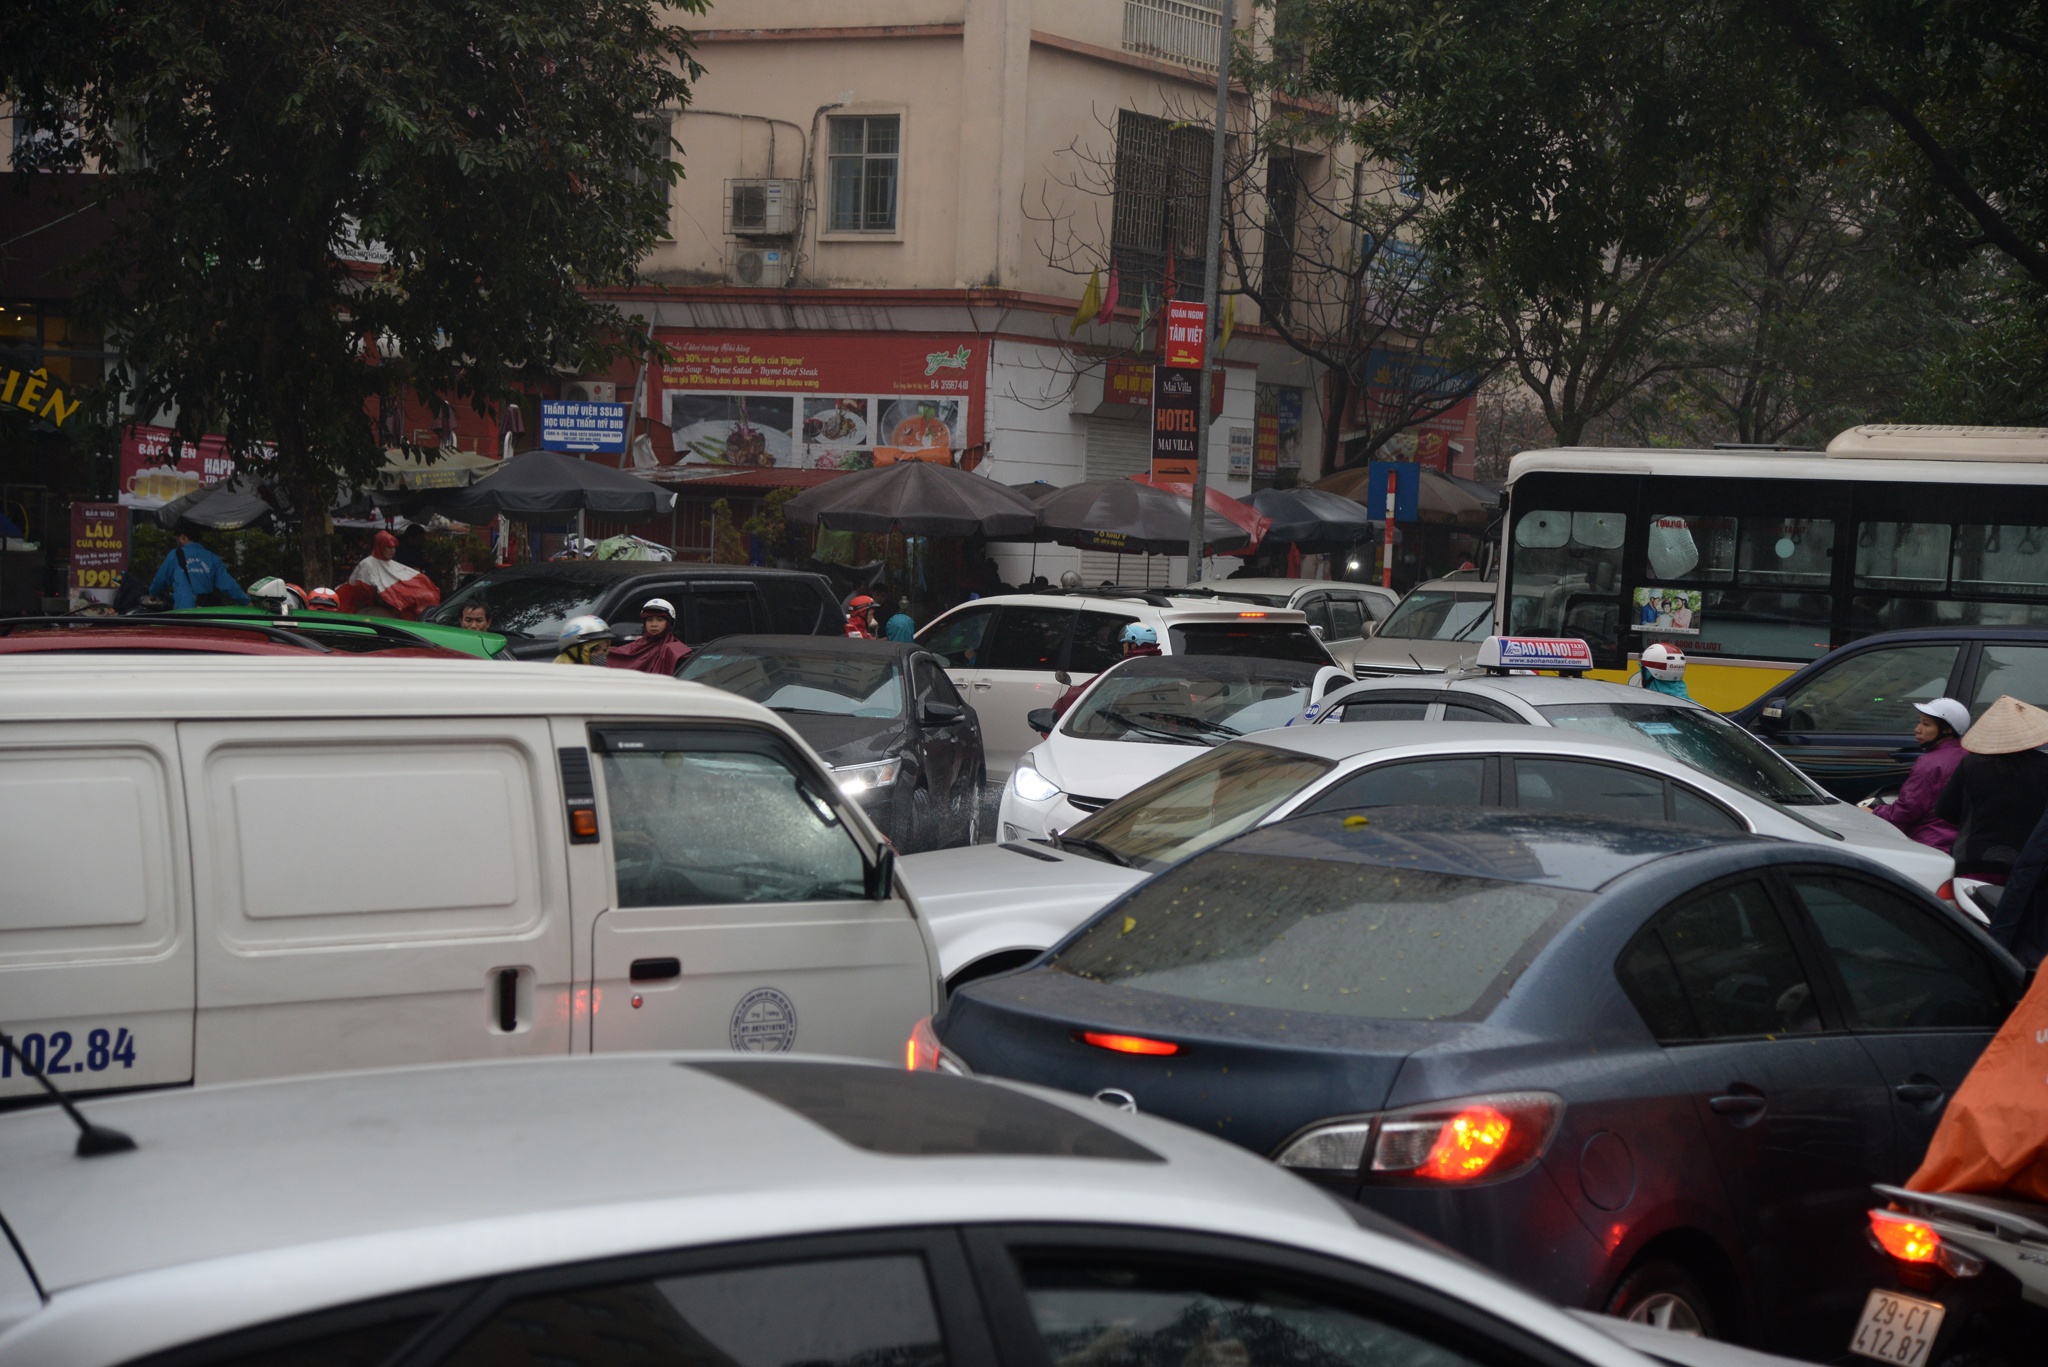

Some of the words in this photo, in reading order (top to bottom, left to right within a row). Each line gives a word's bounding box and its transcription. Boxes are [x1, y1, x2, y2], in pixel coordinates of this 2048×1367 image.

[1171, 308, 1187, 319] QUÁN
[1187, 310, 1204, 320] NGON
[1169, 323, 1186, 342] TÂM
[1187, 325, 1203, 346] VIỆT
[685, 354, 702, 363] 30%
[685, 365, 703, 374] Soup
[710, 365, 732, 376] Thyme
[732, 366, 752, 375] Salad
[760, 366, 782, 376] Thyme
[782, 367, 799, 377] Beef
[799, 368, 819, 376] Steak
[690, 374, 705, 385] 10%
[931, 379, 939, 390] 04
[1163, 380, 1177, 392] Mai
[1176, 381, 1192, 393] Villa
[0, 366, 82, 428] IÊN
[600, 406, 623, 417] SSLAB
[544, 417, 558, 429] HỌC
[559, 416, 575, 430] VIỆN
[1157, 408, 1197, 432] HOTEL
[1157, 438, 1172, 451] MAI
[1173, 438, 1194, 452] VILLA
[204, 458, 237, 475] HAPP
[76, 539, 94, 549] CUA
[1509, 657, 1582, 665] www.saohanoitaxi.com
[0, 1027, 136, 1078] 102.84
[1857, 1324, 1926, 1364] 412.87
